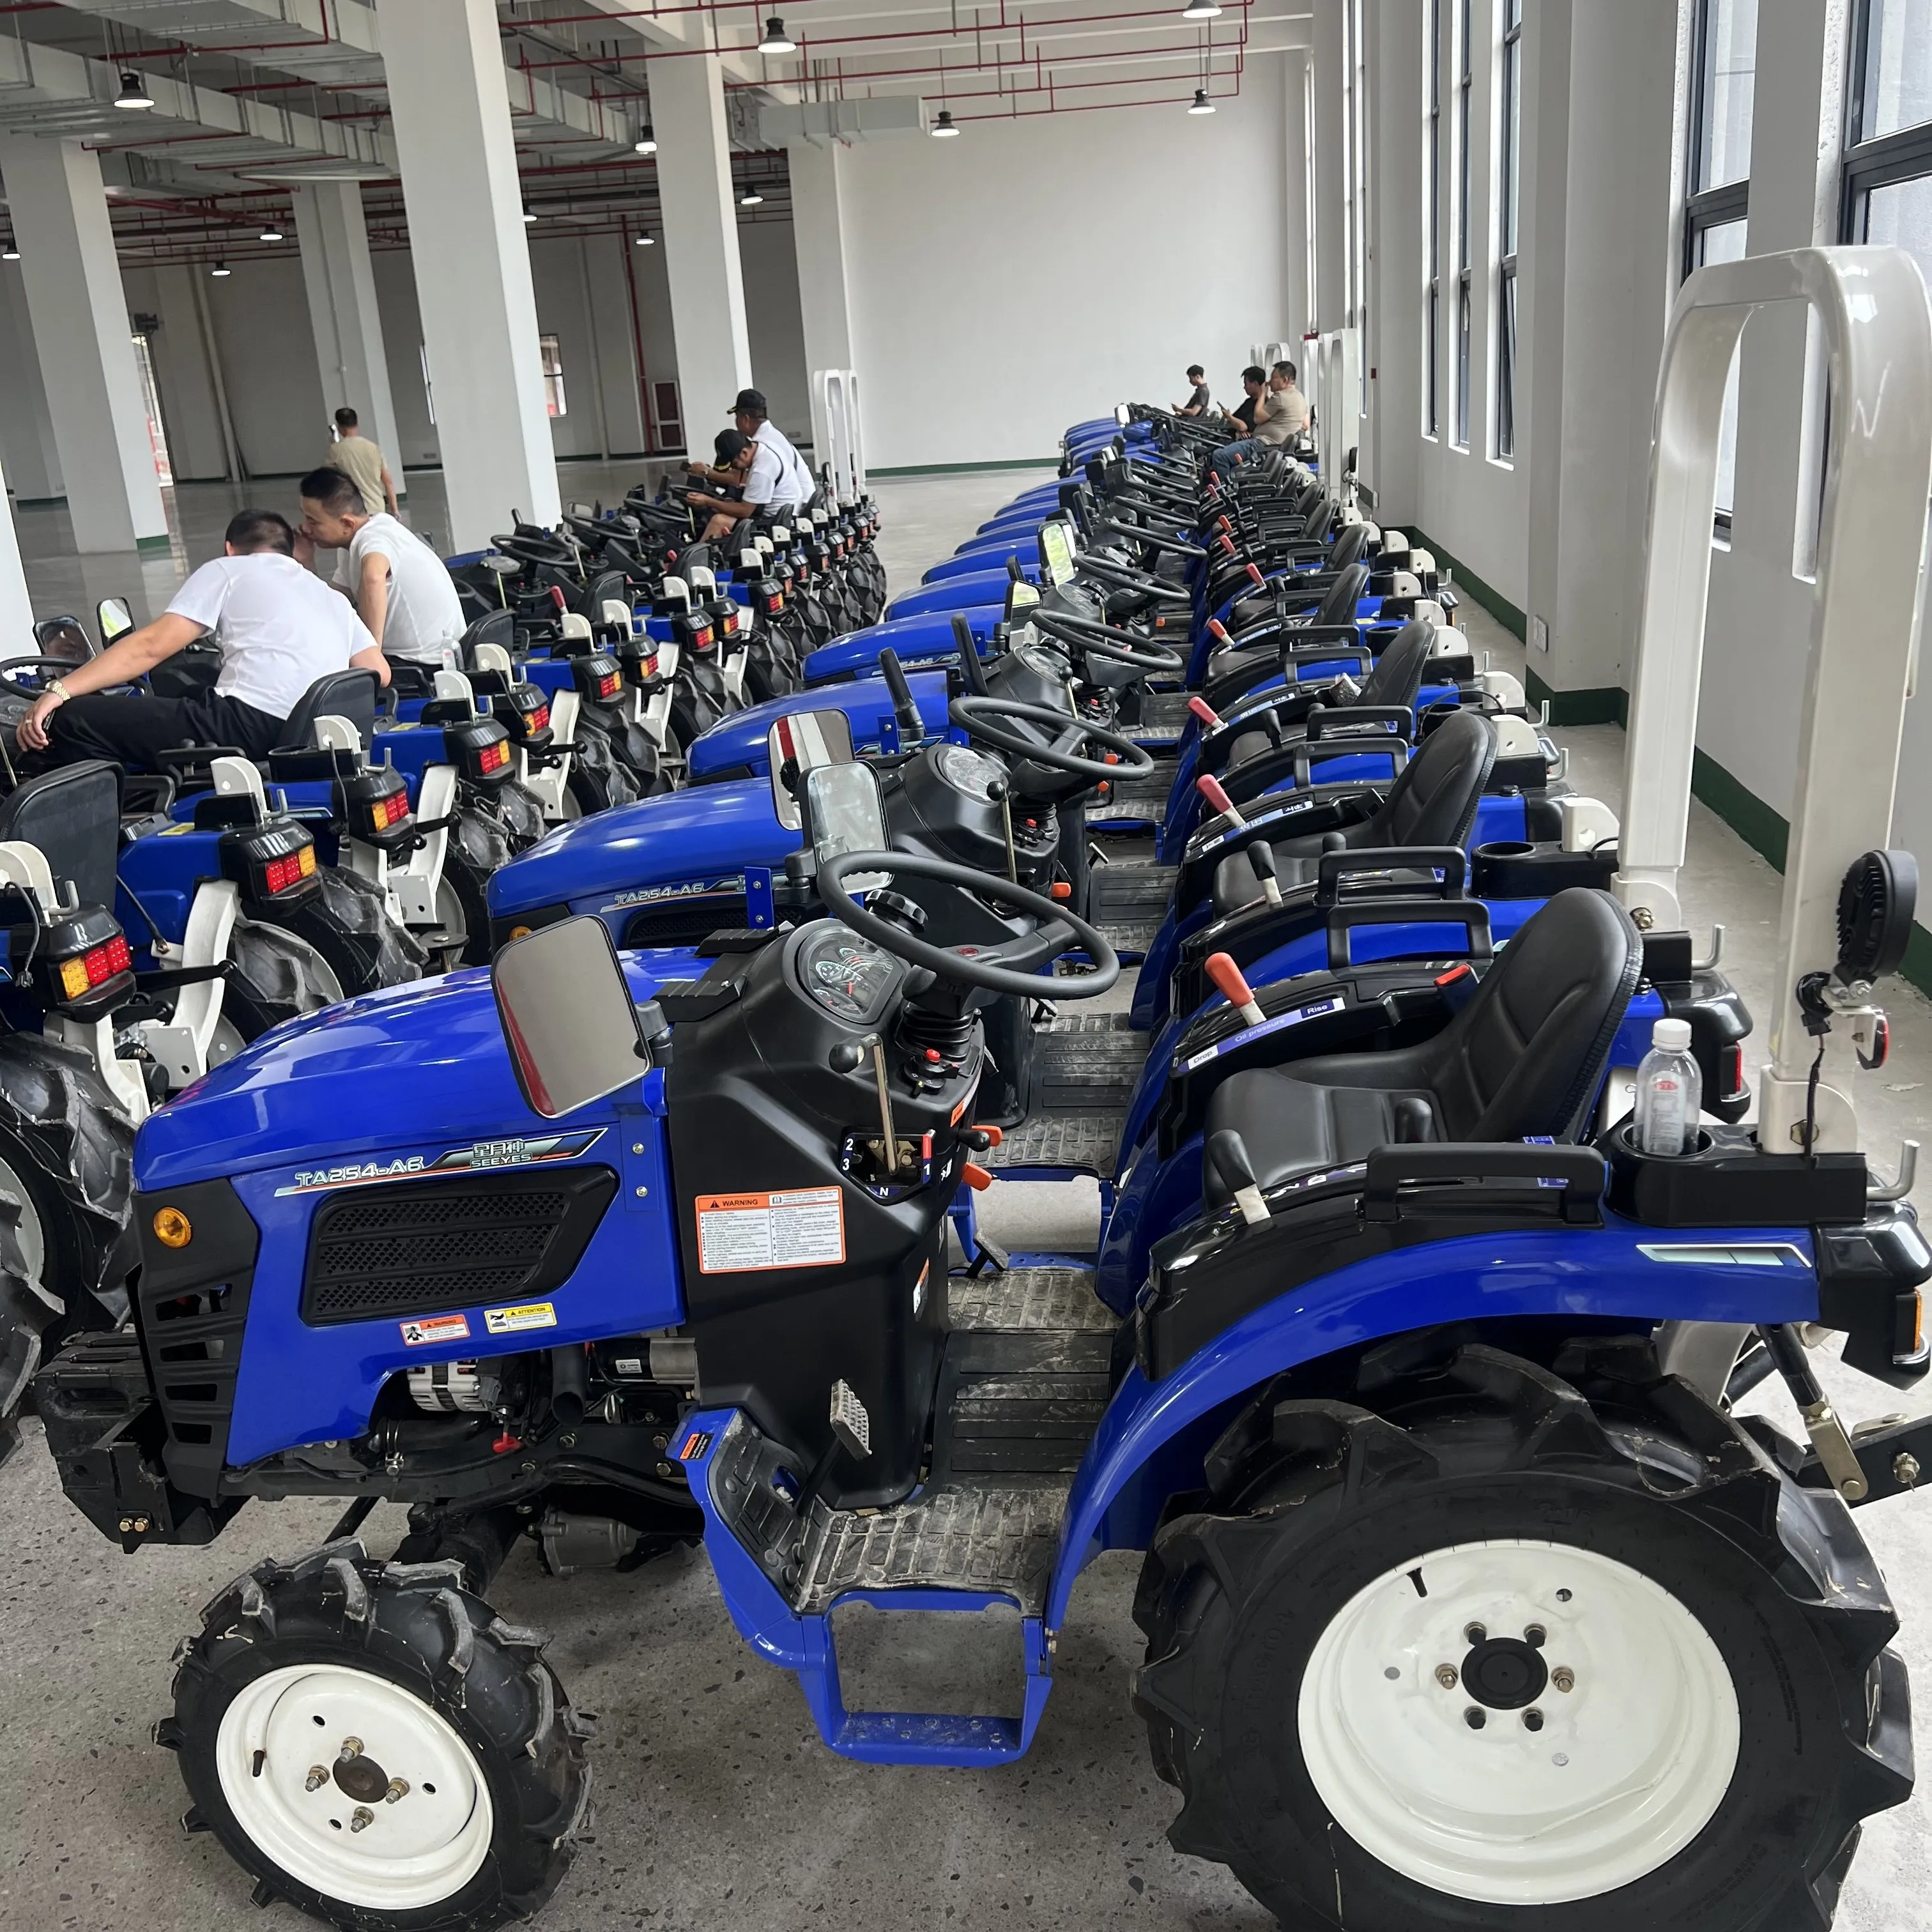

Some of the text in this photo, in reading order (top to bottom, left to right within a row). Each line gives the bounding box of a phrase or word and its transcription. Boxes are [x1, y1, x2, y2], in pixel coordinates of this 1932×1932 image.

[615, 882, 705, 906] TA254-A6
[1307, 1004, 1328, 1015] Rise
[1234, 1018, 1285, 1043] Oil pressure
[1193, 1050, 1213, 1064] Drop
[473, 1140, 525, 1158] 星月神
[845, 1138, 854, 1151] 2
[471, 1153, 532, 1168] SEEYES
[841, 1158, 850, 1171] 3
[295, 1156, 424, 1186] TA254-A6
[923, 1163, 930, 1176] 1
[879, 1187, 889, 1197] N
[722, 1199, 758, 1207] WARNING
